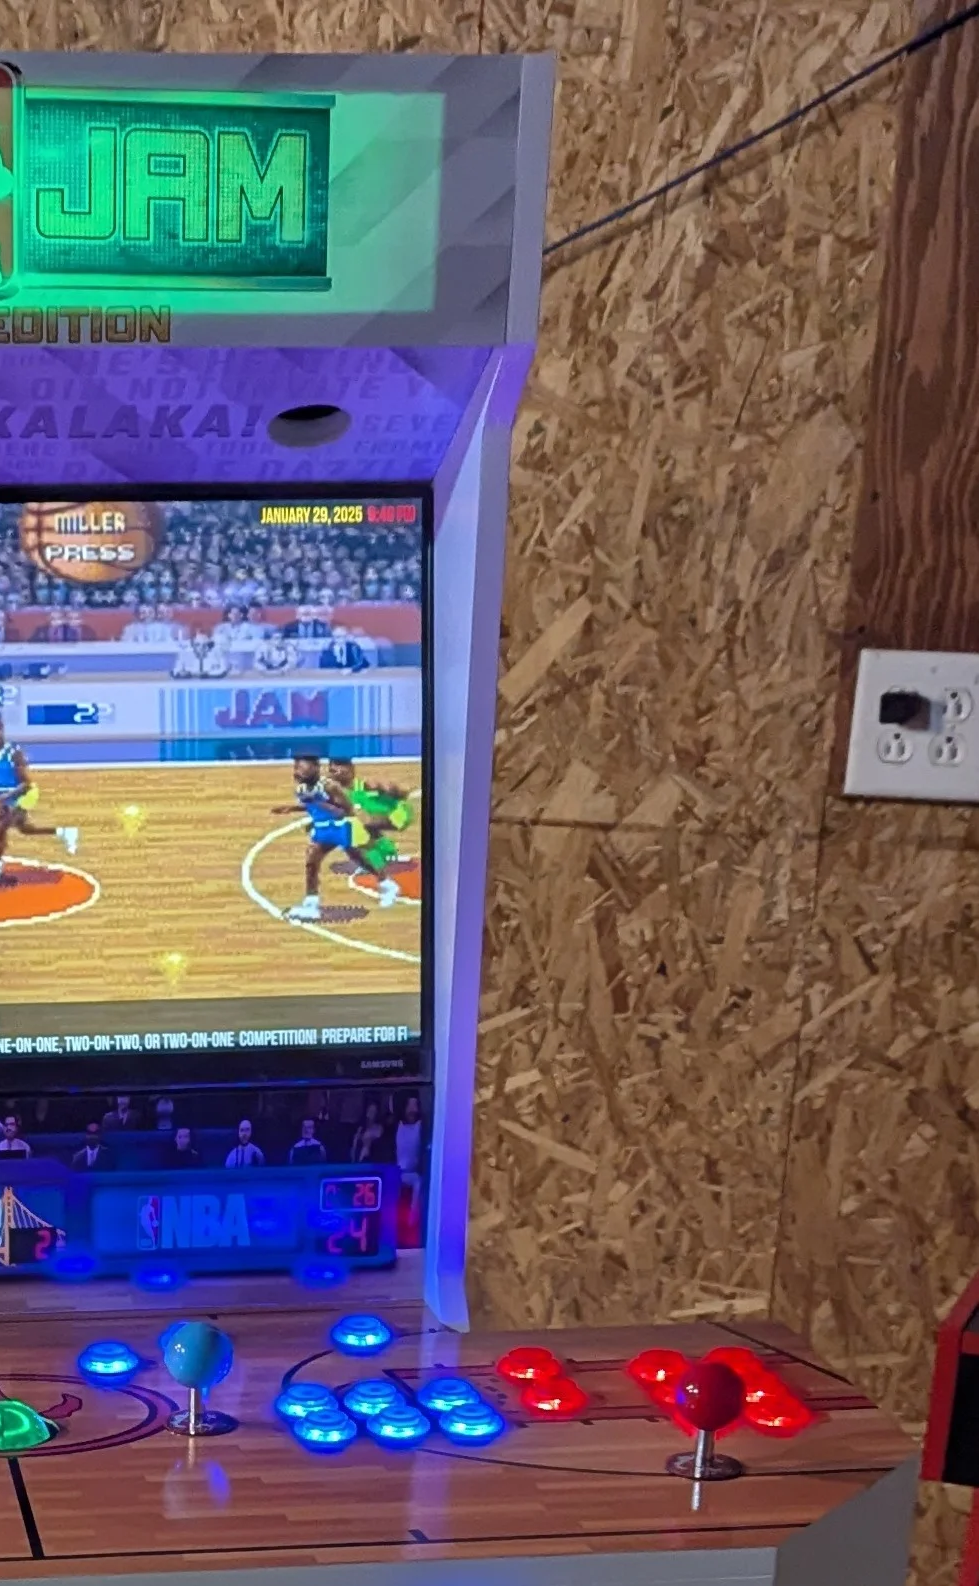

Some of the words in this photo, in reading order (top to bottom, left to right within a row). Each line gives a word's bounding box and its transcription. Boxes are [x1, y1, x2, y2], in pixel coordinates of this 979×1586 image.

[32, 124, 307, 247] JAM
[54, 511, 125, 534] MILLER
[260, 506, 311, 524] JANUARY
[44, 543, 135, 562] PRESS
[213, 688, 329, 729] JAM
[65, 1033, 143, 1053] TWO-ON-TWO,
[145, 1033, 161, 1049] OR
[162, 1031, 235, 1050] TWO-ON-ONE
[239, 1029, 318, 1048] COMPETITION!
[321, 1027, 373, 1044] PREPARE
[374, 1026, 396, 1042] FOR
[161, 1193, 251, 1249] NBA
